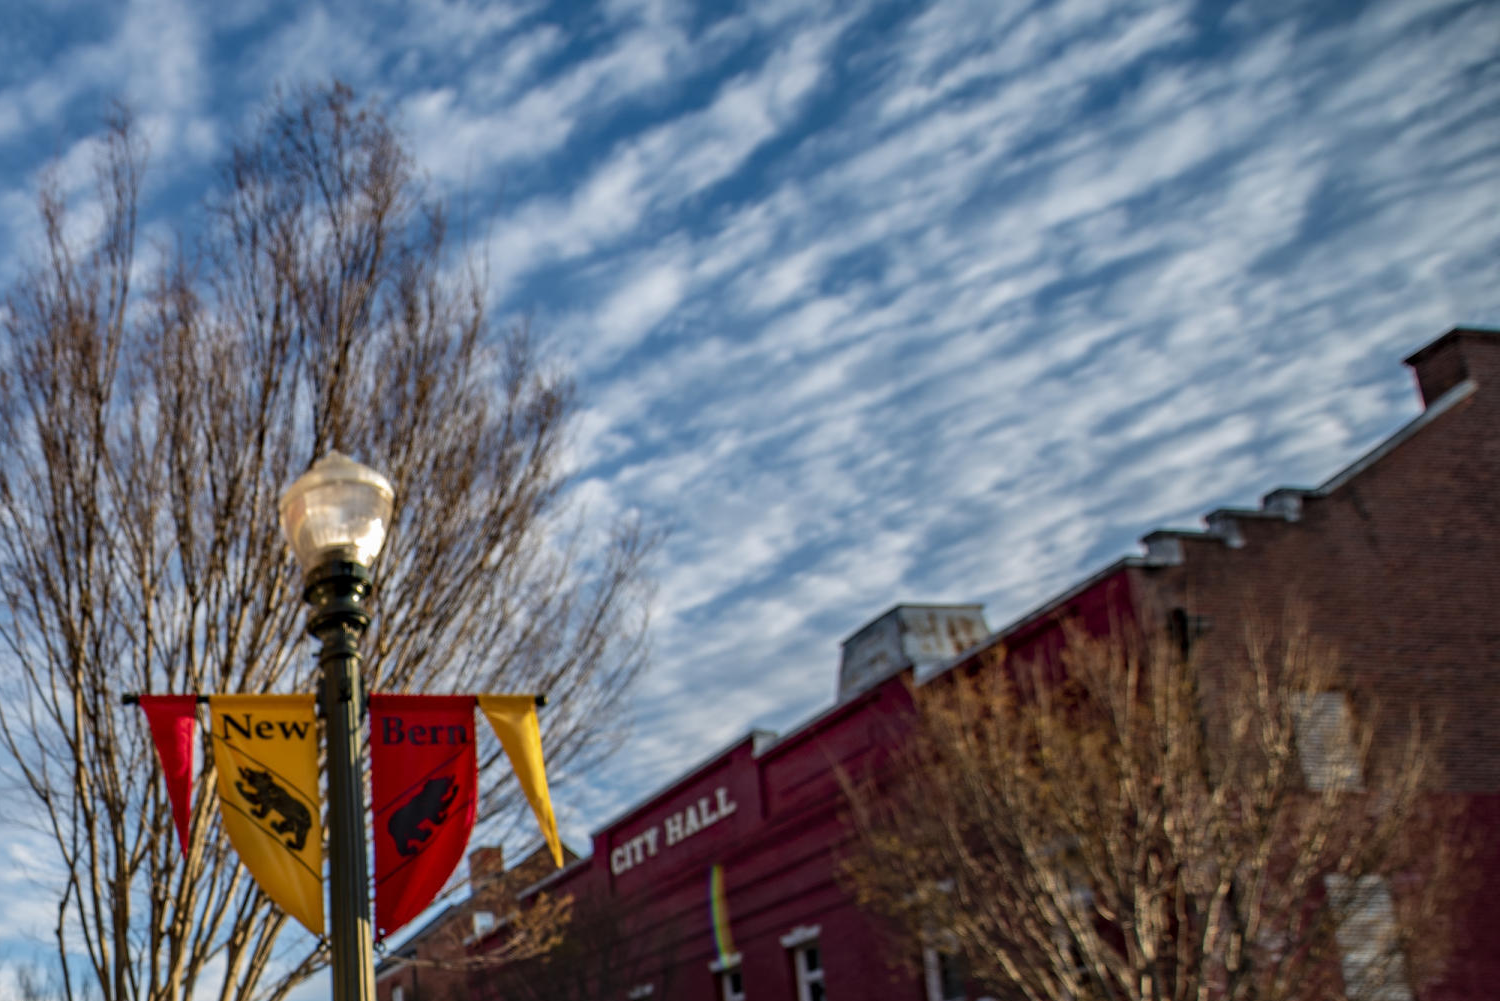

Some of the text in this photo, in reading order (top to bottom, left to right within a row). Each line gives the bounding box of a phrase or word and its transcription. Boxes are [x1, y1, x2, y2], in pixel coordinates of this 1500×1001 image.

[221, 713, 468, 747] New Bern
[610, 786, 737, 876] CITY HALL
